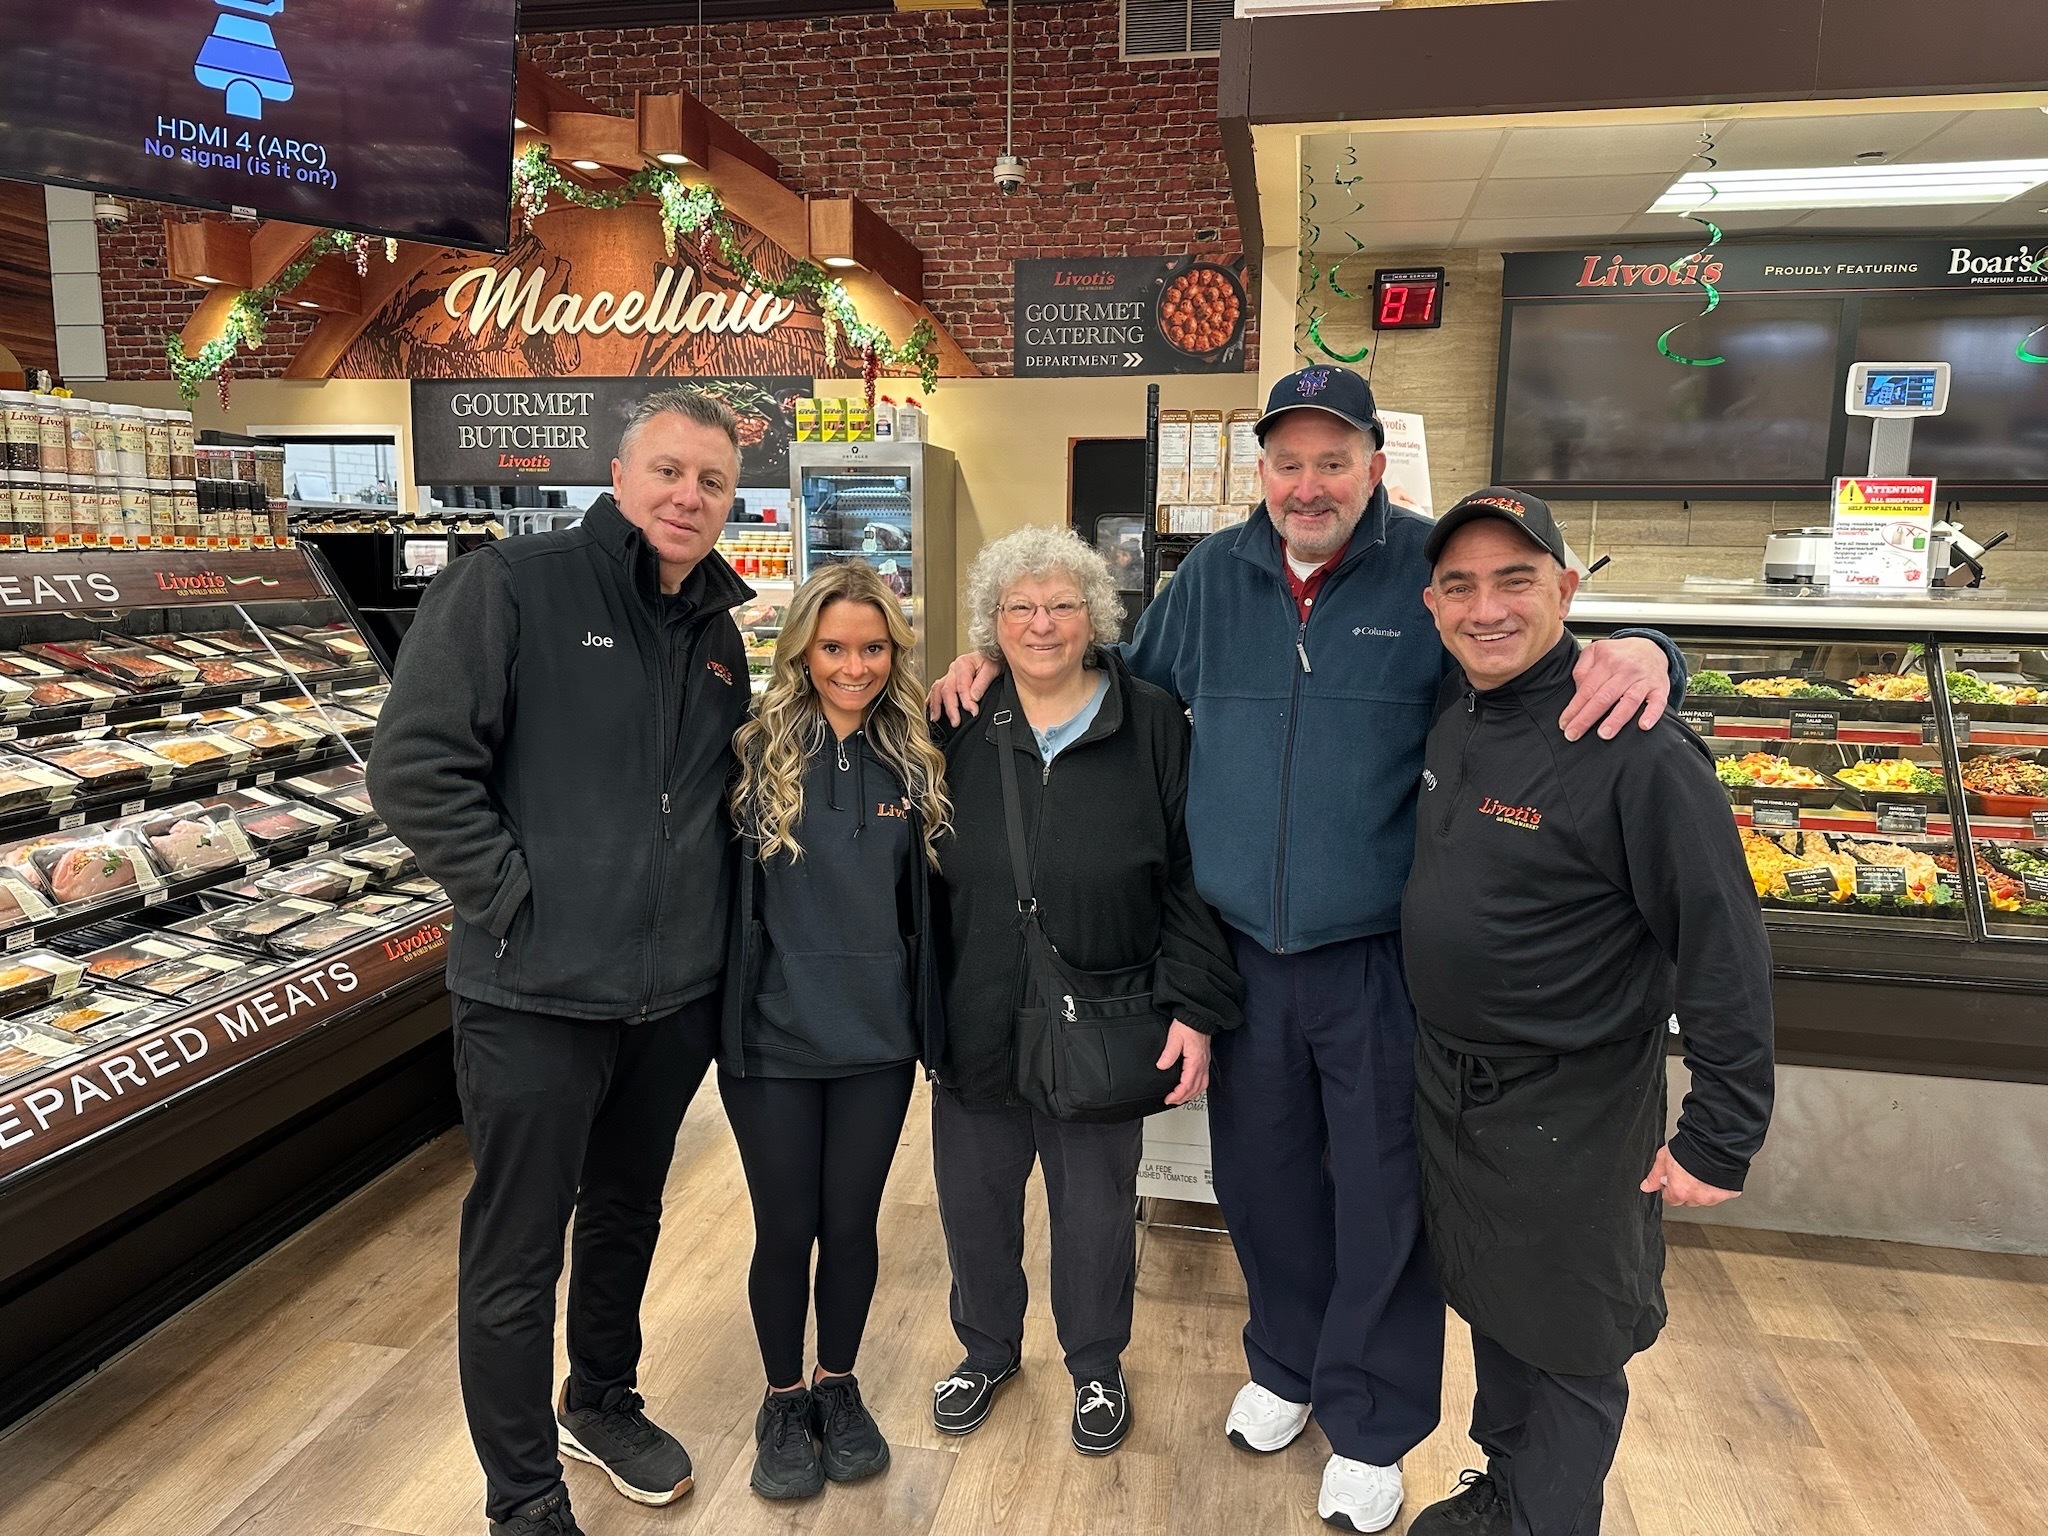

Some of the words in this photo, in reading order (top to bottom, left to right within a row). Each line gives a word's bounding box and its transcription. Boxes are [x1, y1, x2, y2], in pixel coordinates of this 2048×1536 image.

[157, 115, 228, 148] HDMI
[236, 131, 251, 152] 4
[258, 134, 327, 169] (ARC)
[144, 137, 175, 159] No
[181, 144, 241, 170] signal
[247, 155, 271, 176] (is
[276, 160, 291, 179] it
[296, 166, 338, 190] on?)
[1576, 253, 1724, 287] Livoti's
[1947, 245, 2033, 274] Boar's
[1053, 270, 1116, 286] Livoti's
[1970, 276, 2015, 284] PREMIUM
[444, 265, 795, 337] Macellaio
[1381, 287, 1436, 322] 81
[1025, 302, 1145, 323] GOURMET
[1025, 325, 1145, 346] CATERING
[1026, 354, 1118, 367] DEPARTMENT
[451, 392, 595, 418] GOURMET
[458, 424, 590, 450] BUTCHER
[498, 454, 551, 468] Livoti's
[1865, 485, 1925, 494] ATTENTION
[154, 571, 226, 590] Livoti's
[581, 631, 614, 648] Joe
[1361, 626, 1401, 637] Columbia
[1479, 796, 1542, 825] Livoti's
[382, 924, 442, 961] Livoti's
[215, 962, 359, 1043] MEATS
[1155, 1165, 1172, 1173] FEDE
[1163, 1174, 1198, 1184] TOMATOES
